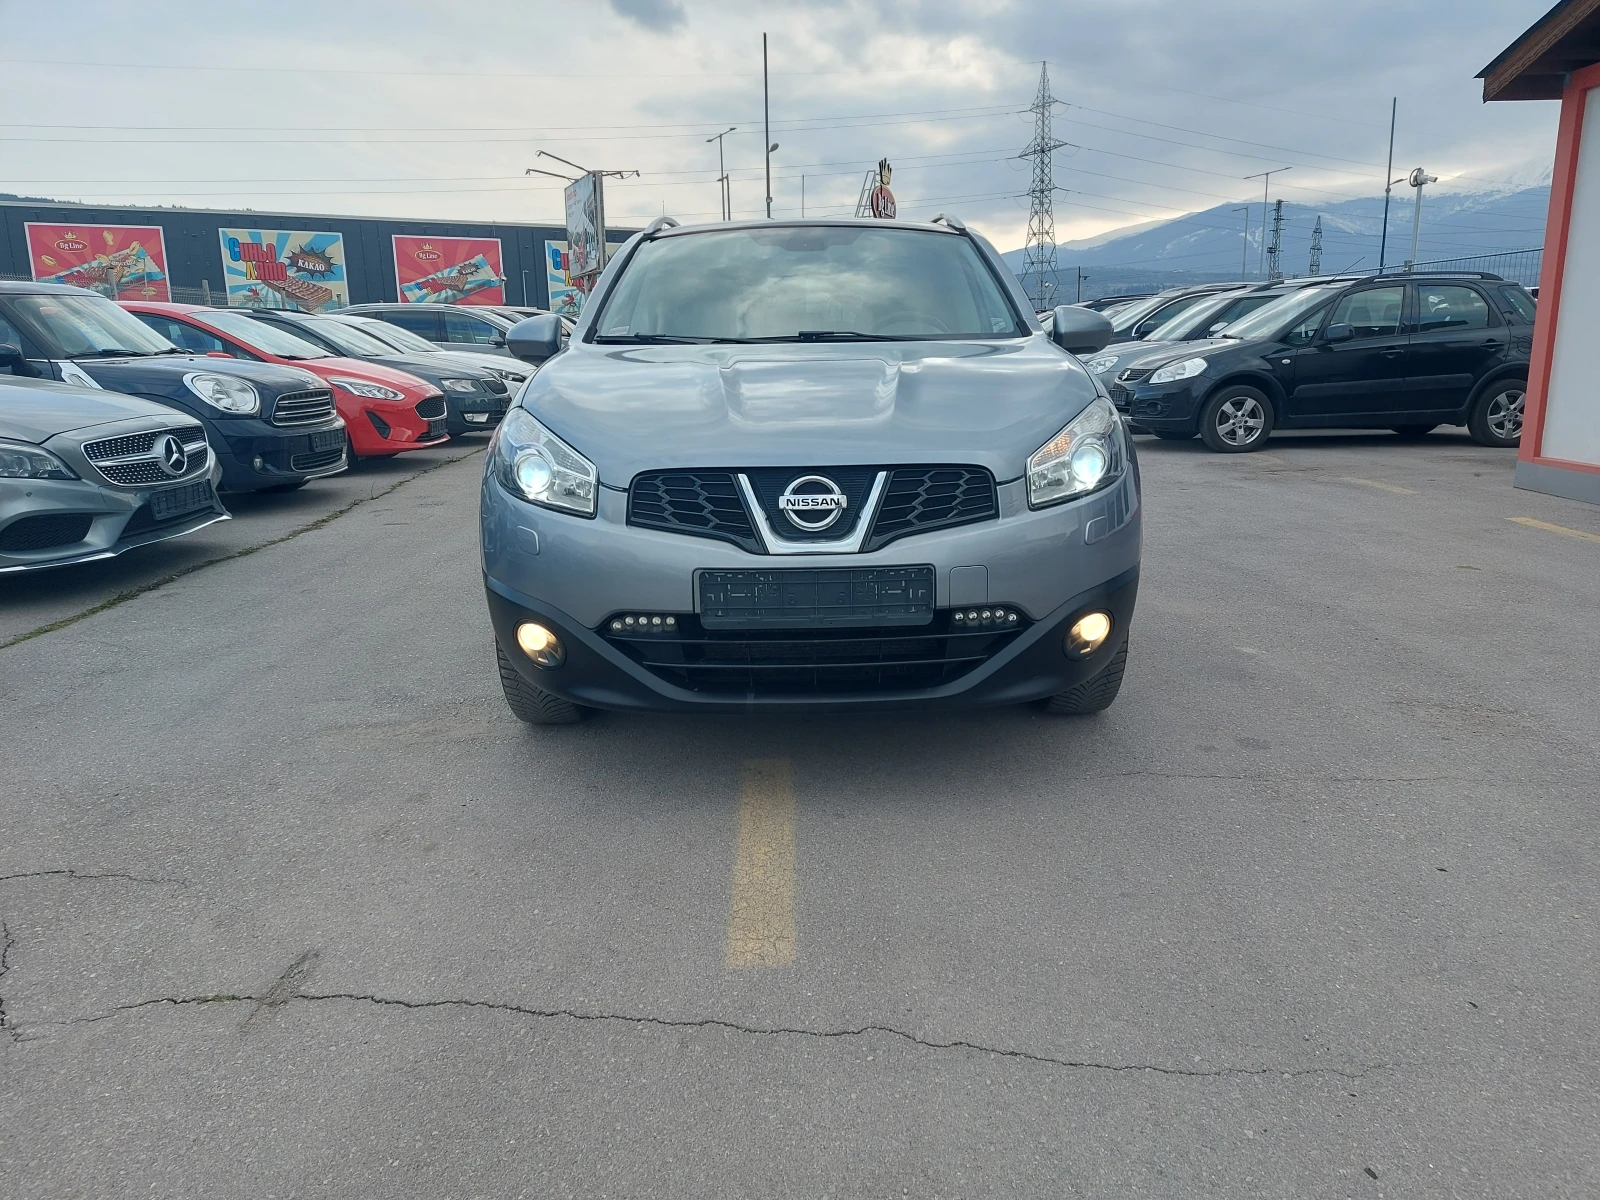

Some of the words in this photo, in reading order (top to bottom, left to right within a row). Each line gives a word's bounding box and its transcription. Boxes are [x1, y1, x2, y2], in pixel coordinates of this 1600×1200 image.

[60, 242, 69, 250] Bg
[297, 259, 325, 272] КАКАО
[786, 498, 840, 507] NISSAN
